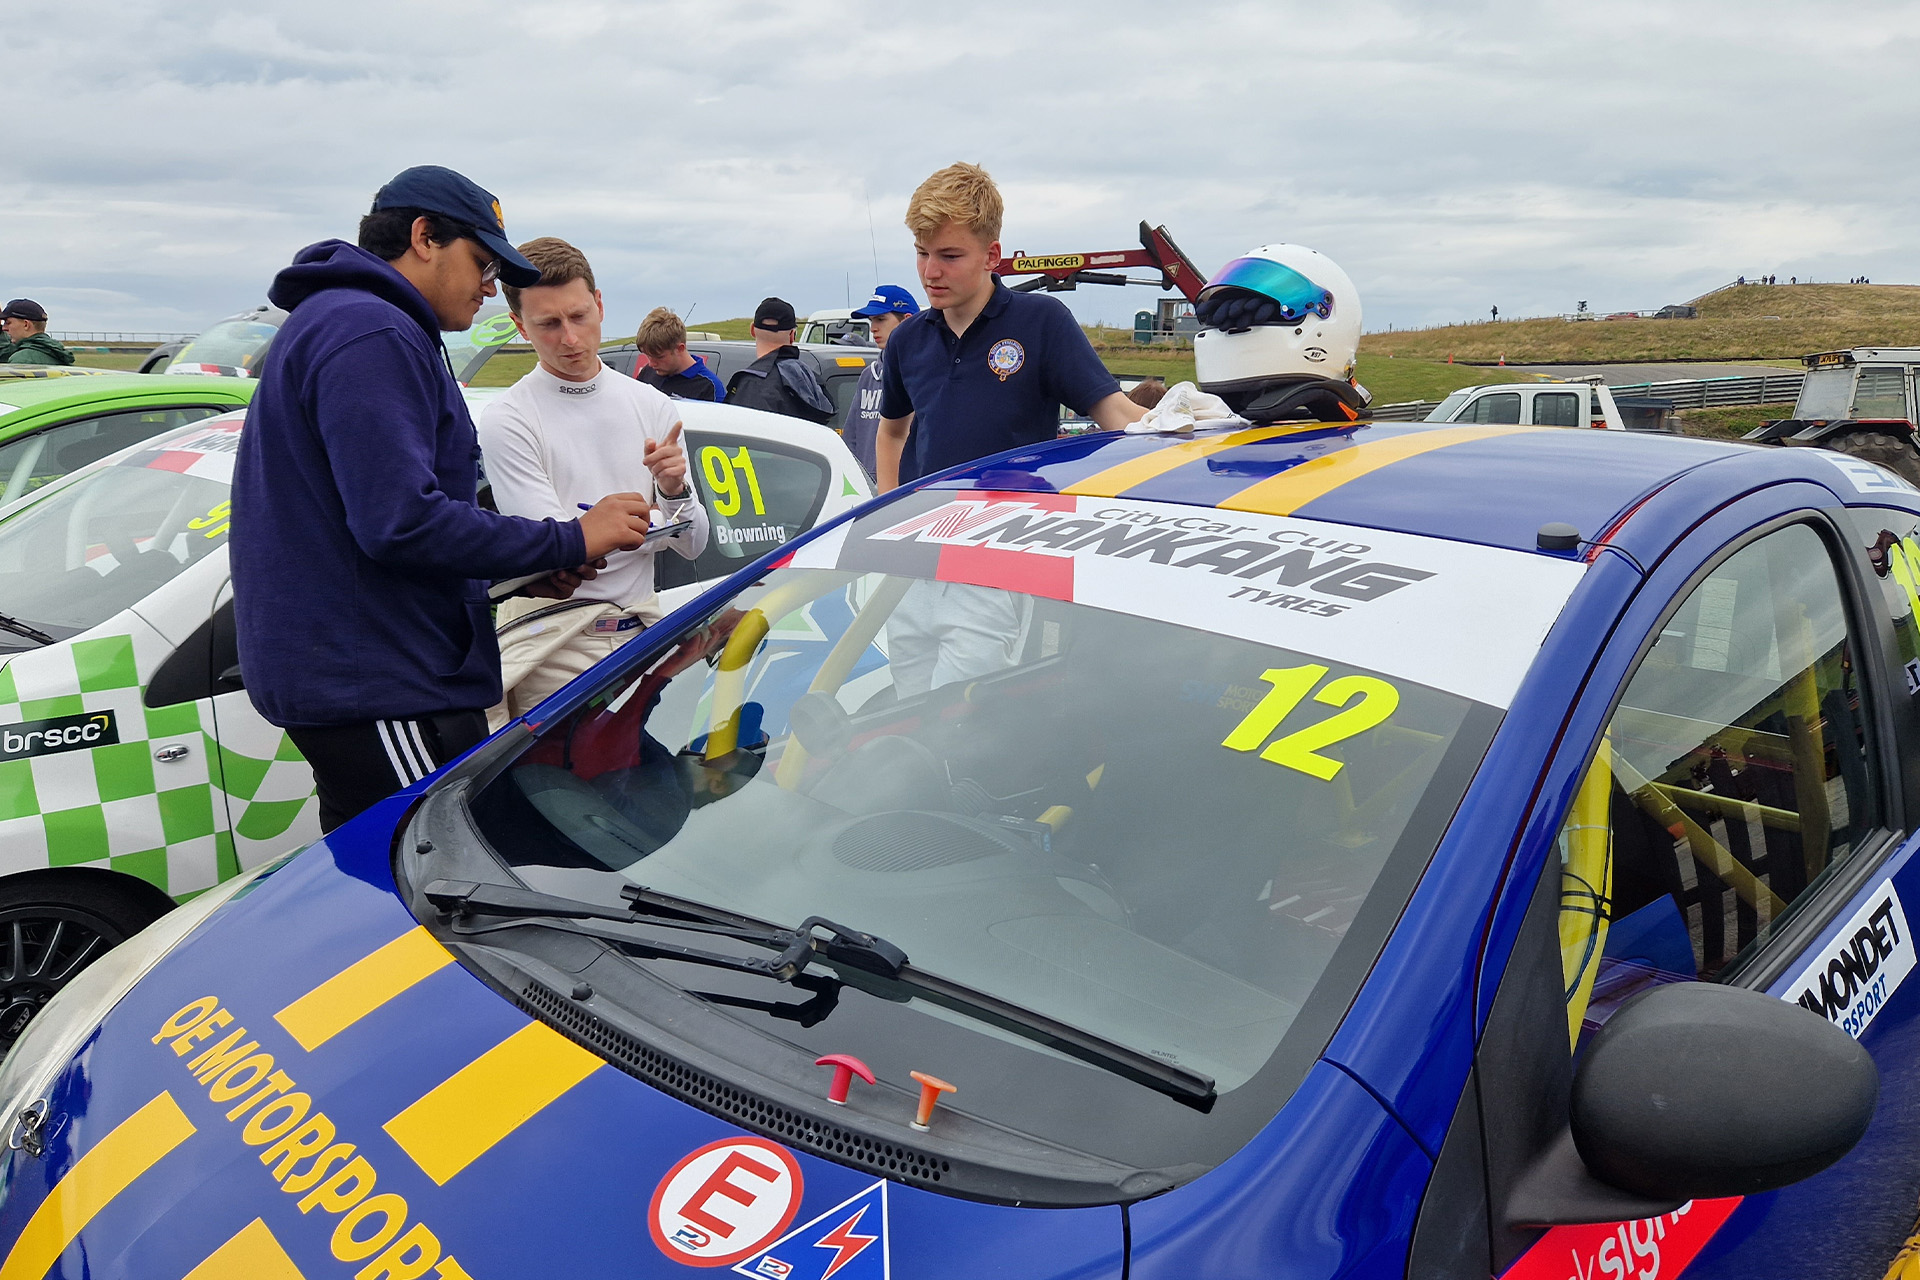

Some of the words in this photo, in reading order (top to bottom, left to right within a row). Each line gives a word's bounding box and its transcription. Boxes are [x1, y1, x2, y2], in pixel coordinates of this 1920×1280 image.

[1017, 256, 1079, 269] PALFINGER
[559, 383, 597, 395] sparco
[701, 445, 766, 517] 91
[716, 522, 786, 544] Browning
[1092, 507, 1258, 535] CityCar
[1266, 529, 1372, 556] Cup
[966, 513, 1439, 602] NANKANG
[1227, 585, 1352, 618] TYRES
[3, 722, 101, 754] brscc
[1220, 663, 1400, 782] 12
[151, 995, 235, 1057] QE
[677, 1150, 782, 1240] E
